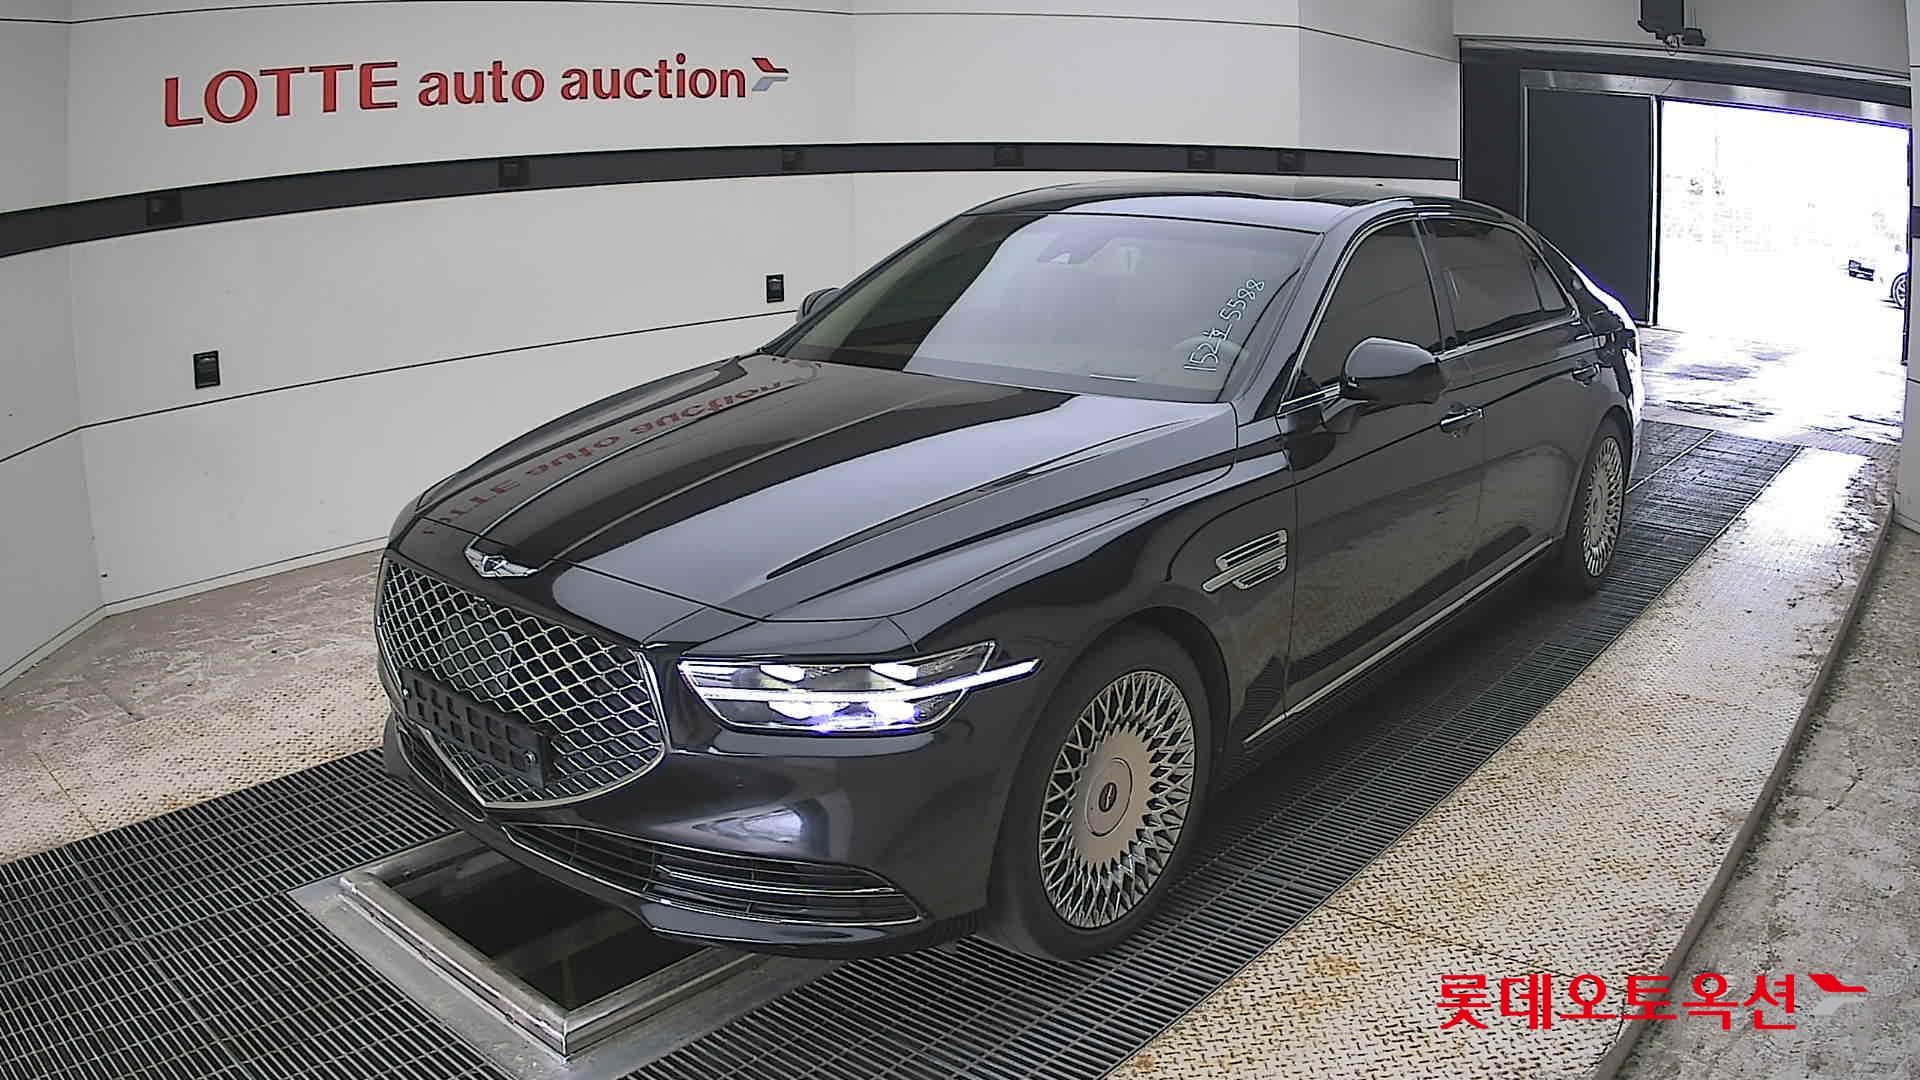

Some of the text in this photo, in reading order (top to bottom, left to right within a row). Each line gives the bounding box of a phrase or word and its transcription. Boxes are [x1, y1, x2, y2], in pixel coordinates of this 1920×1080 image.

[164, 52, 748, 128] LOTTE auto auction
[1219, 279, 1265, 321] 5588
